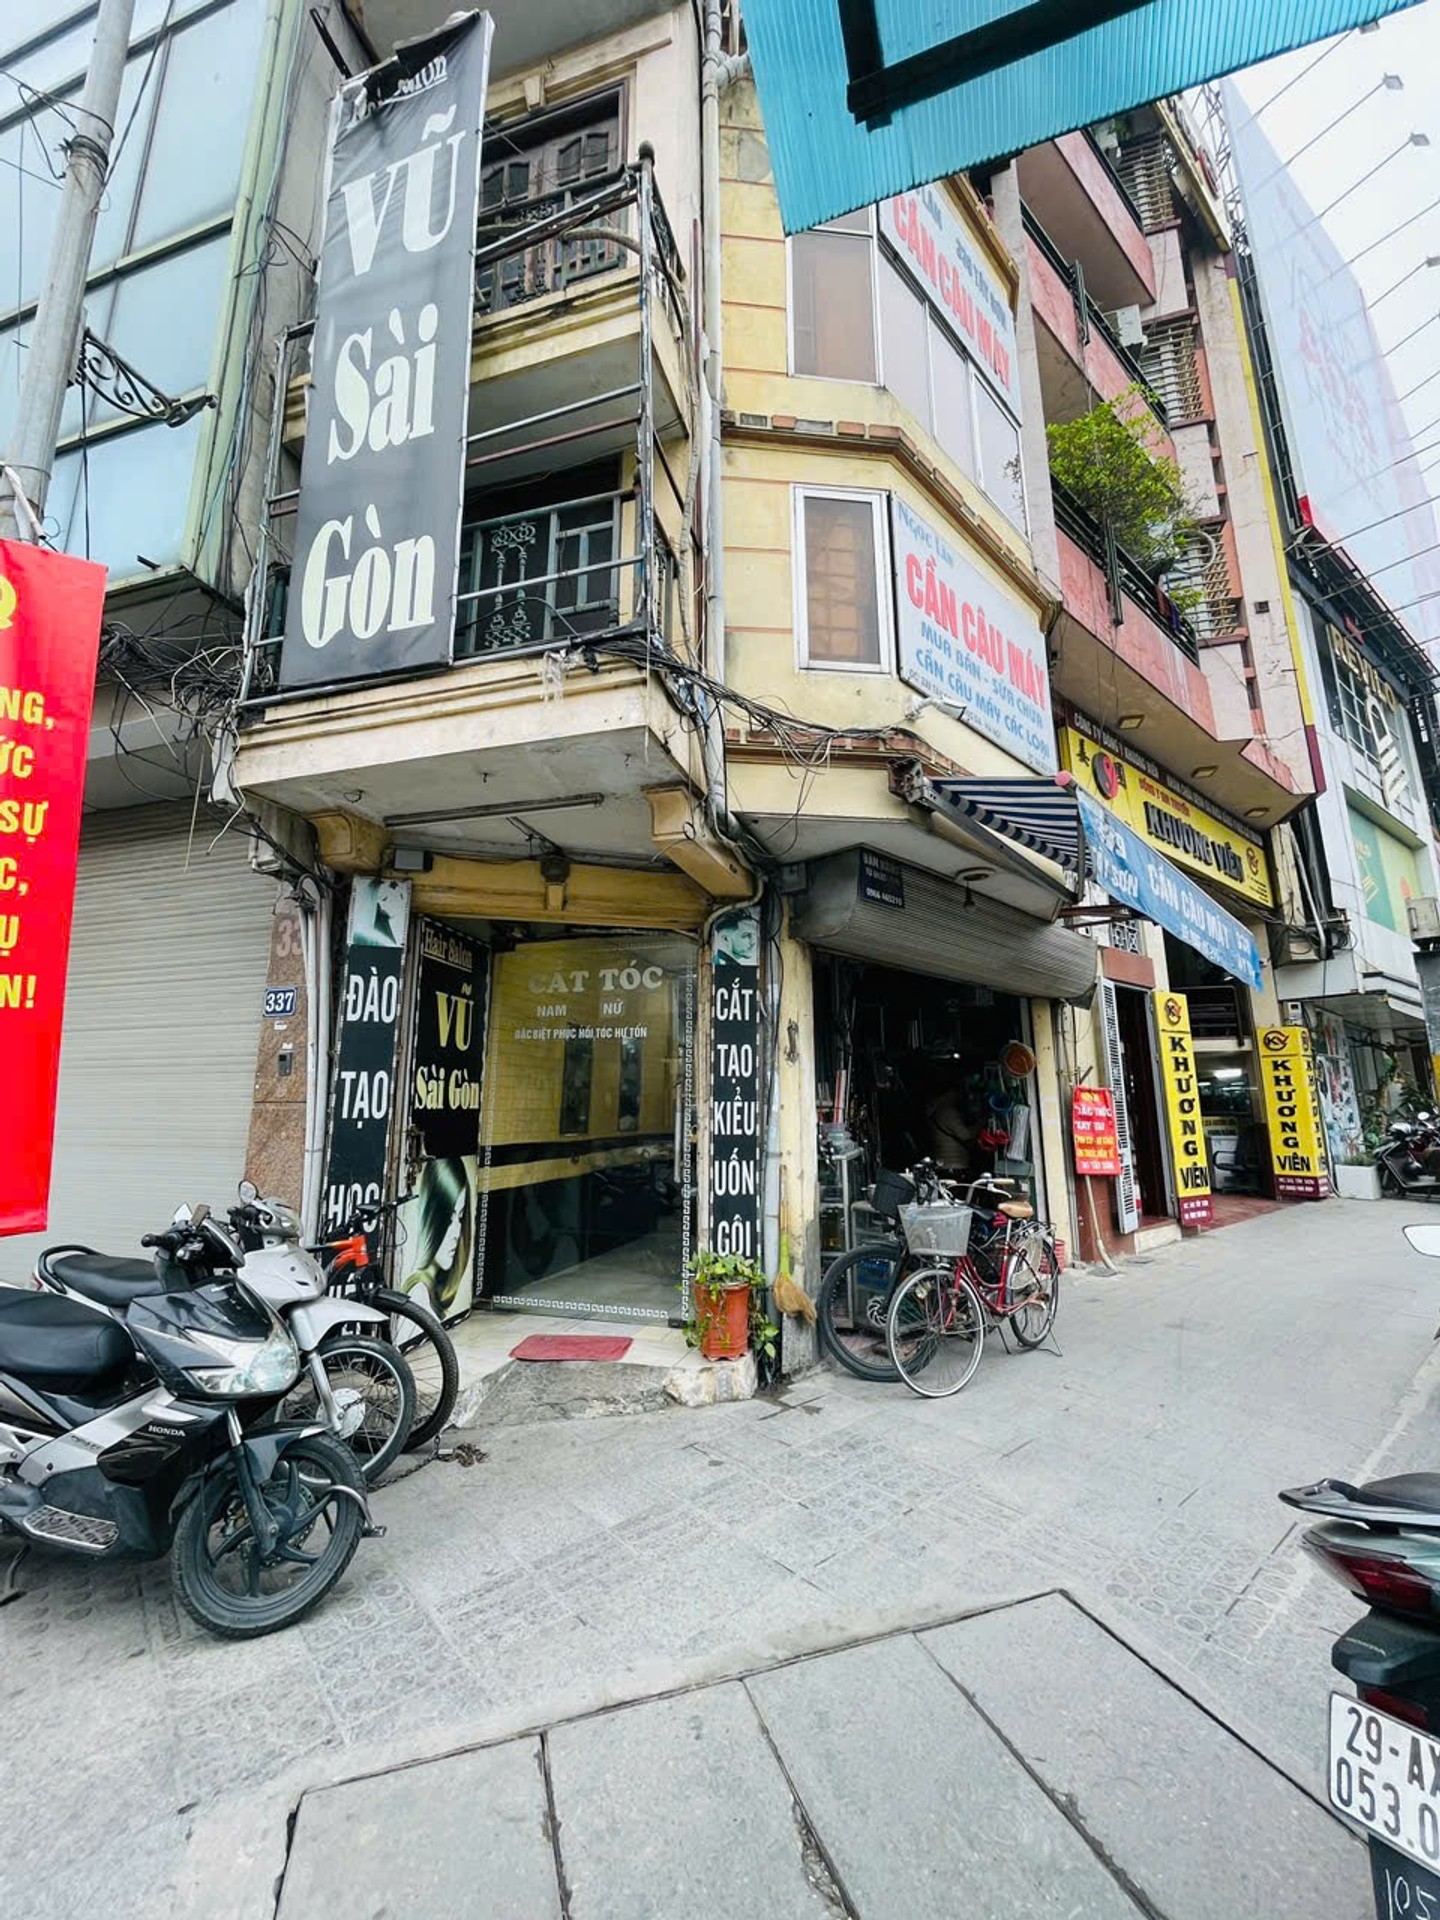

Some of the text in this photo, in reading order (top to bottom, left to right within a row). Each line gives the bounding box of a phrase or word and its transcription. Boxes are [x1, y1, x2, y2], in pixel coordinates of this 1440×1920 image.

[340, 105, 466, 277] VŨ
[326, 303, 438, 465] Sài
[301, 503, 435, 649] Gòn
[906, 553, 959, 639] CẦN
[961, 602, 1005, 675] CÂU
[1006, 638, 1046, 711] MÁY
[0, 801, 49, 842] SỰ
[1143, 800, 1213, 866] KHƯƠNG
[424, 929, 473, 968] Hair Salon
[346, 966, 398, 1024] ĐÀO
[599, 960, 662, 991] TÓC
[716, 979, 752, 1021] CẮT
[265, 992, 294, 1012] 337
[435, 982, 474, 1052] VŨ
[537, 1004, 567, 1017] NAM
[414, 1062, 480, 1111] Sài Gòn
[716, 1043, 753, 1083] TẠO
[340, 1071, 388, 1128] TẠO
[714, 1087, 755, 1136] KIỂU
[1170, 1036, 1199, 1157] KHƯƠNG
[1272, 1060, 1299, 1149] KHƯƠNG
[714, 1149, 754, 1195] UỐN
[1180, 1161, 1209, 1189] VIÊN
[1277, 1153, 1311, 1172] VIÊN
[148, 1424, 186, 1438] HONDA
